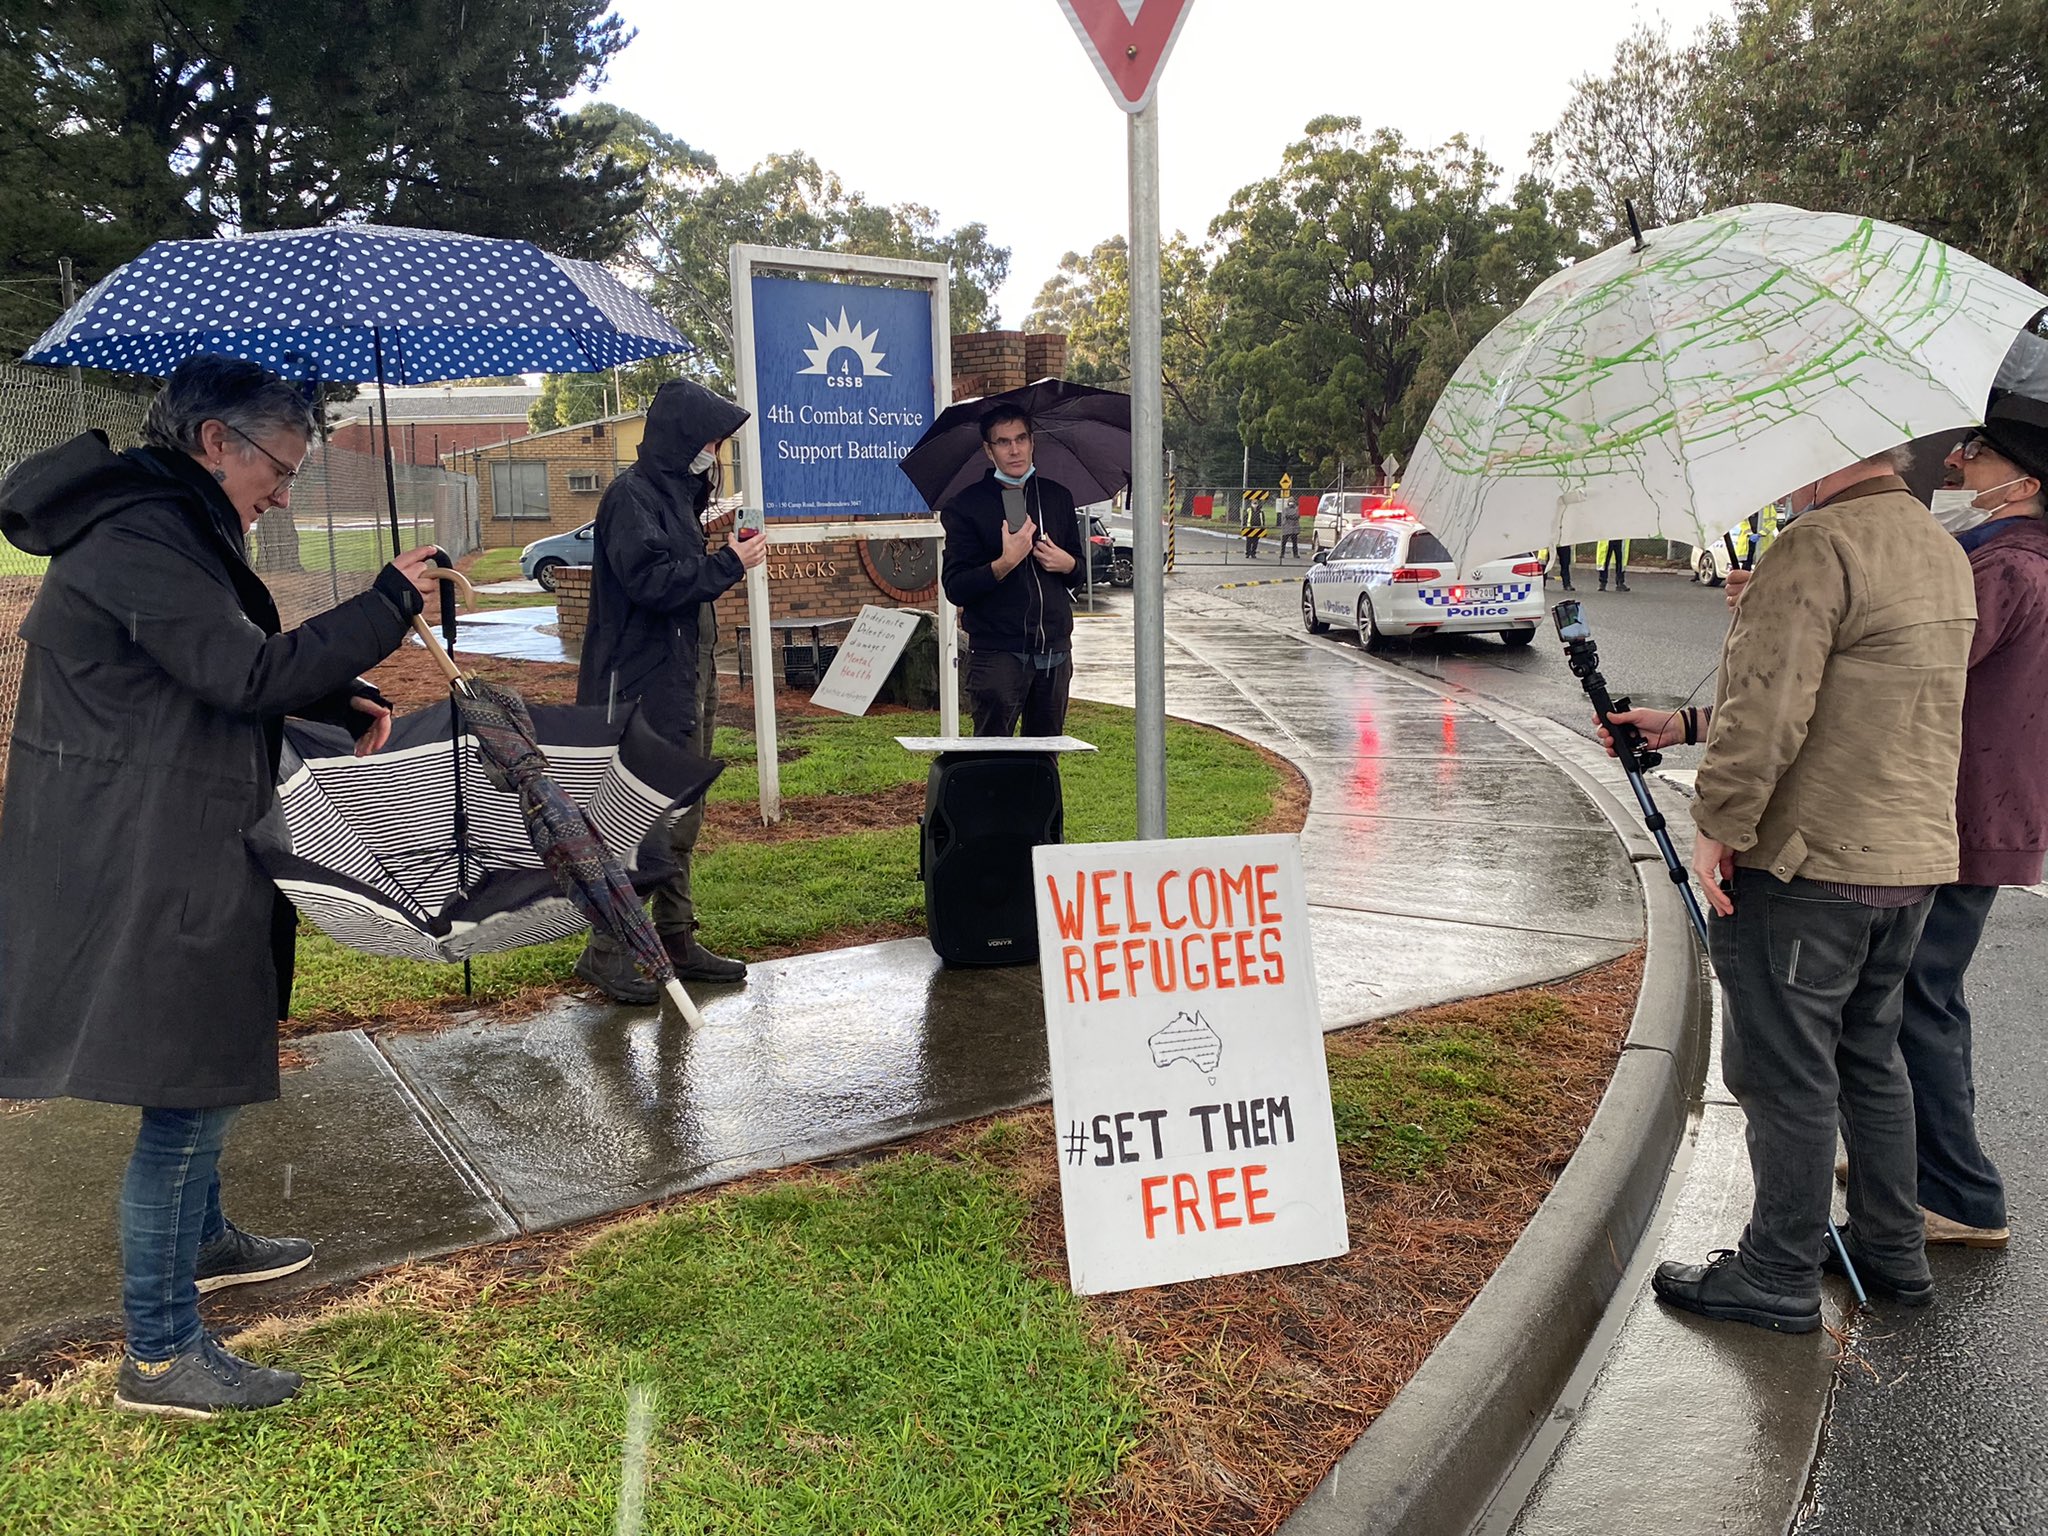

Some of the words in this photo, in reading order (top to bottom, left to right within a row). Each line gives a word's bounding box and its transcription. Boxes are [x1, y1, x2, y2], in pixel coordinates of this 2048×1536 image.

[841, 359, 849, 375] 4
[827, 376, 863, 388] CSSB
[767, 404, 794, 424] 4th
[800, 405, 864, 425] Combat
[868, 407, 923, 426] Service
[778, 440, 842, 464] Support
[767, 561, 836, 580] RRACKS
[861, 608, 905, 629] Indefinite
[1447, 606, 1509, 617] Police
[849, 640, 886, 653] damages
[843, 651, 875, 667] Mental
[840, 665, 871, 681] Health
[1047, 863, 1282, 940] WELCOME
[986, 939, 1013, 947] VONYX
[1062, 928, 1285, 1003] REFUGEES
[1062, 1109, 1168, 1166] #SET
[1189, 1096, 1295, 1153] THEM
[1140, 1165, 1276, 1240] FREE
